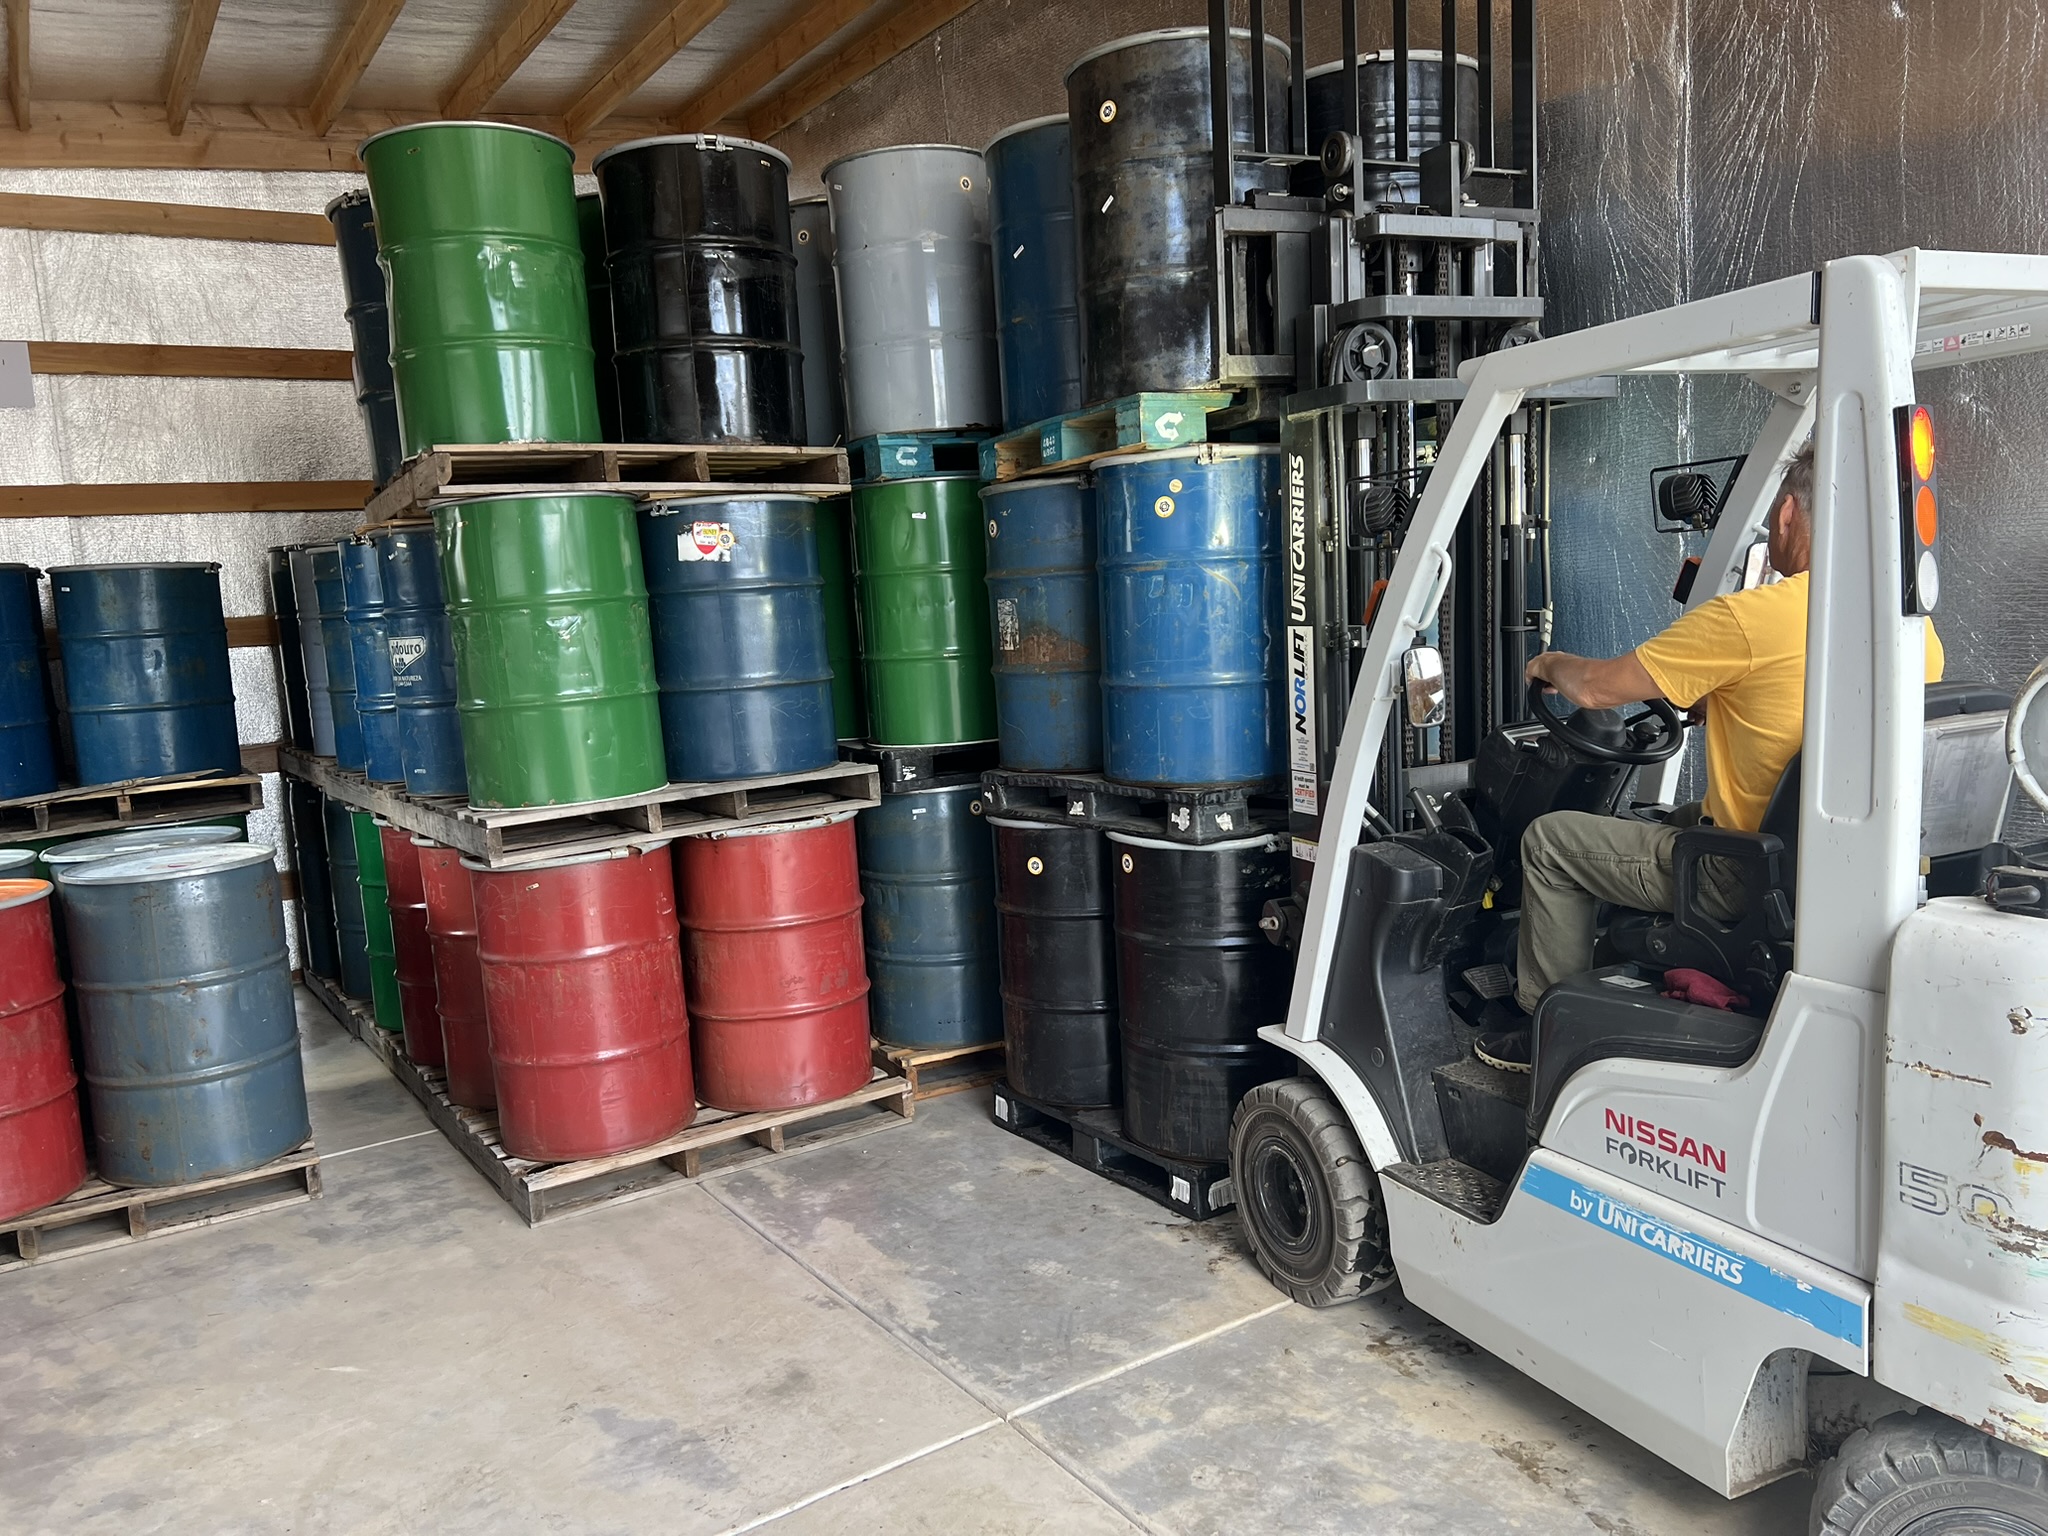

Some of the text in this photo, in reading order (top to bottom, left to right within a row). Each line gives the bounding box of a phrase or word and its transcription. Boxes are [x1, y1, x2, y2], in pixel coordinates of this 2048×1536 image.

[1290, 454, 1307, 622] UNICARRIERS
[1293, 628, 1308, 735] NORLIFT
[1295, 788, 1315, 798] CERTIFIED
[1604, 1108, 1727, 1174] NISSAN
[1606, 1136, 1727, 1199] FORKLIFT
[1569, 1189, 1746, 1285] by UNICARRIERS
